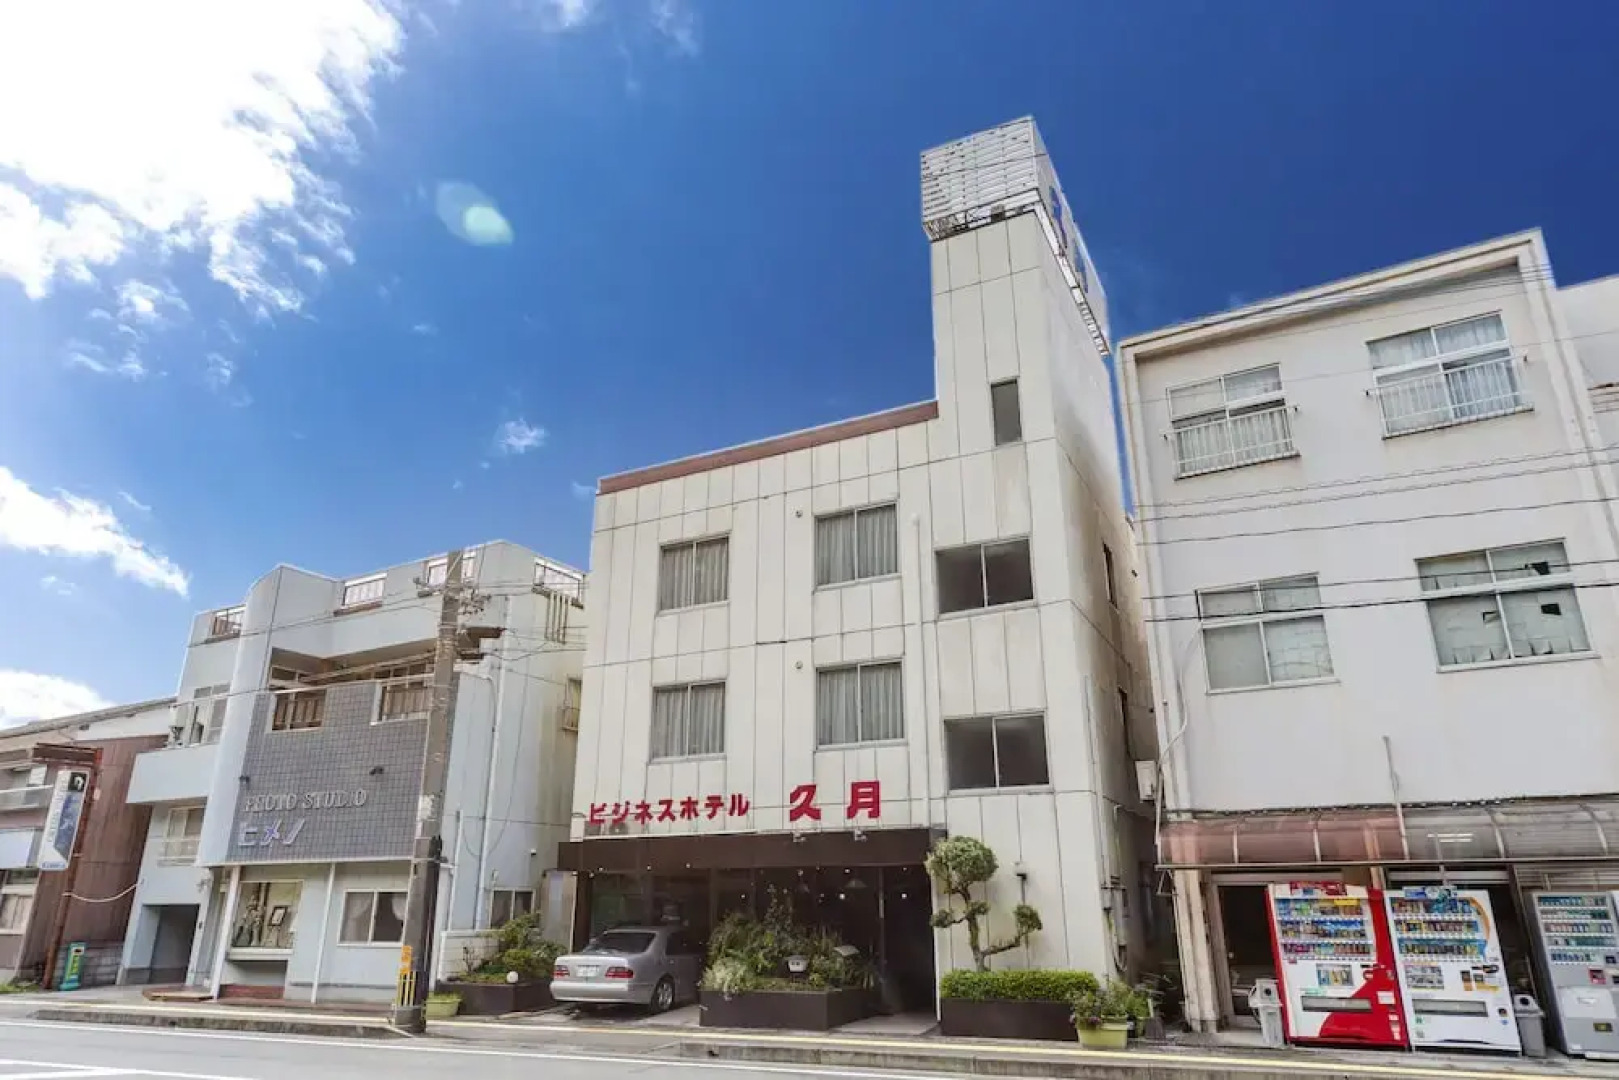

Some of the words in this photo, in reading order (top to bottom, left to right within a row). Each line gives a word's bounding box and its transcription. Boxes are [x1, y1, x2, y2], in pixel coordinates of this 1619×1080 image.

[590, 793, 751, 826] ビジネスホテル
[789, 779, 881, 822] 久月
